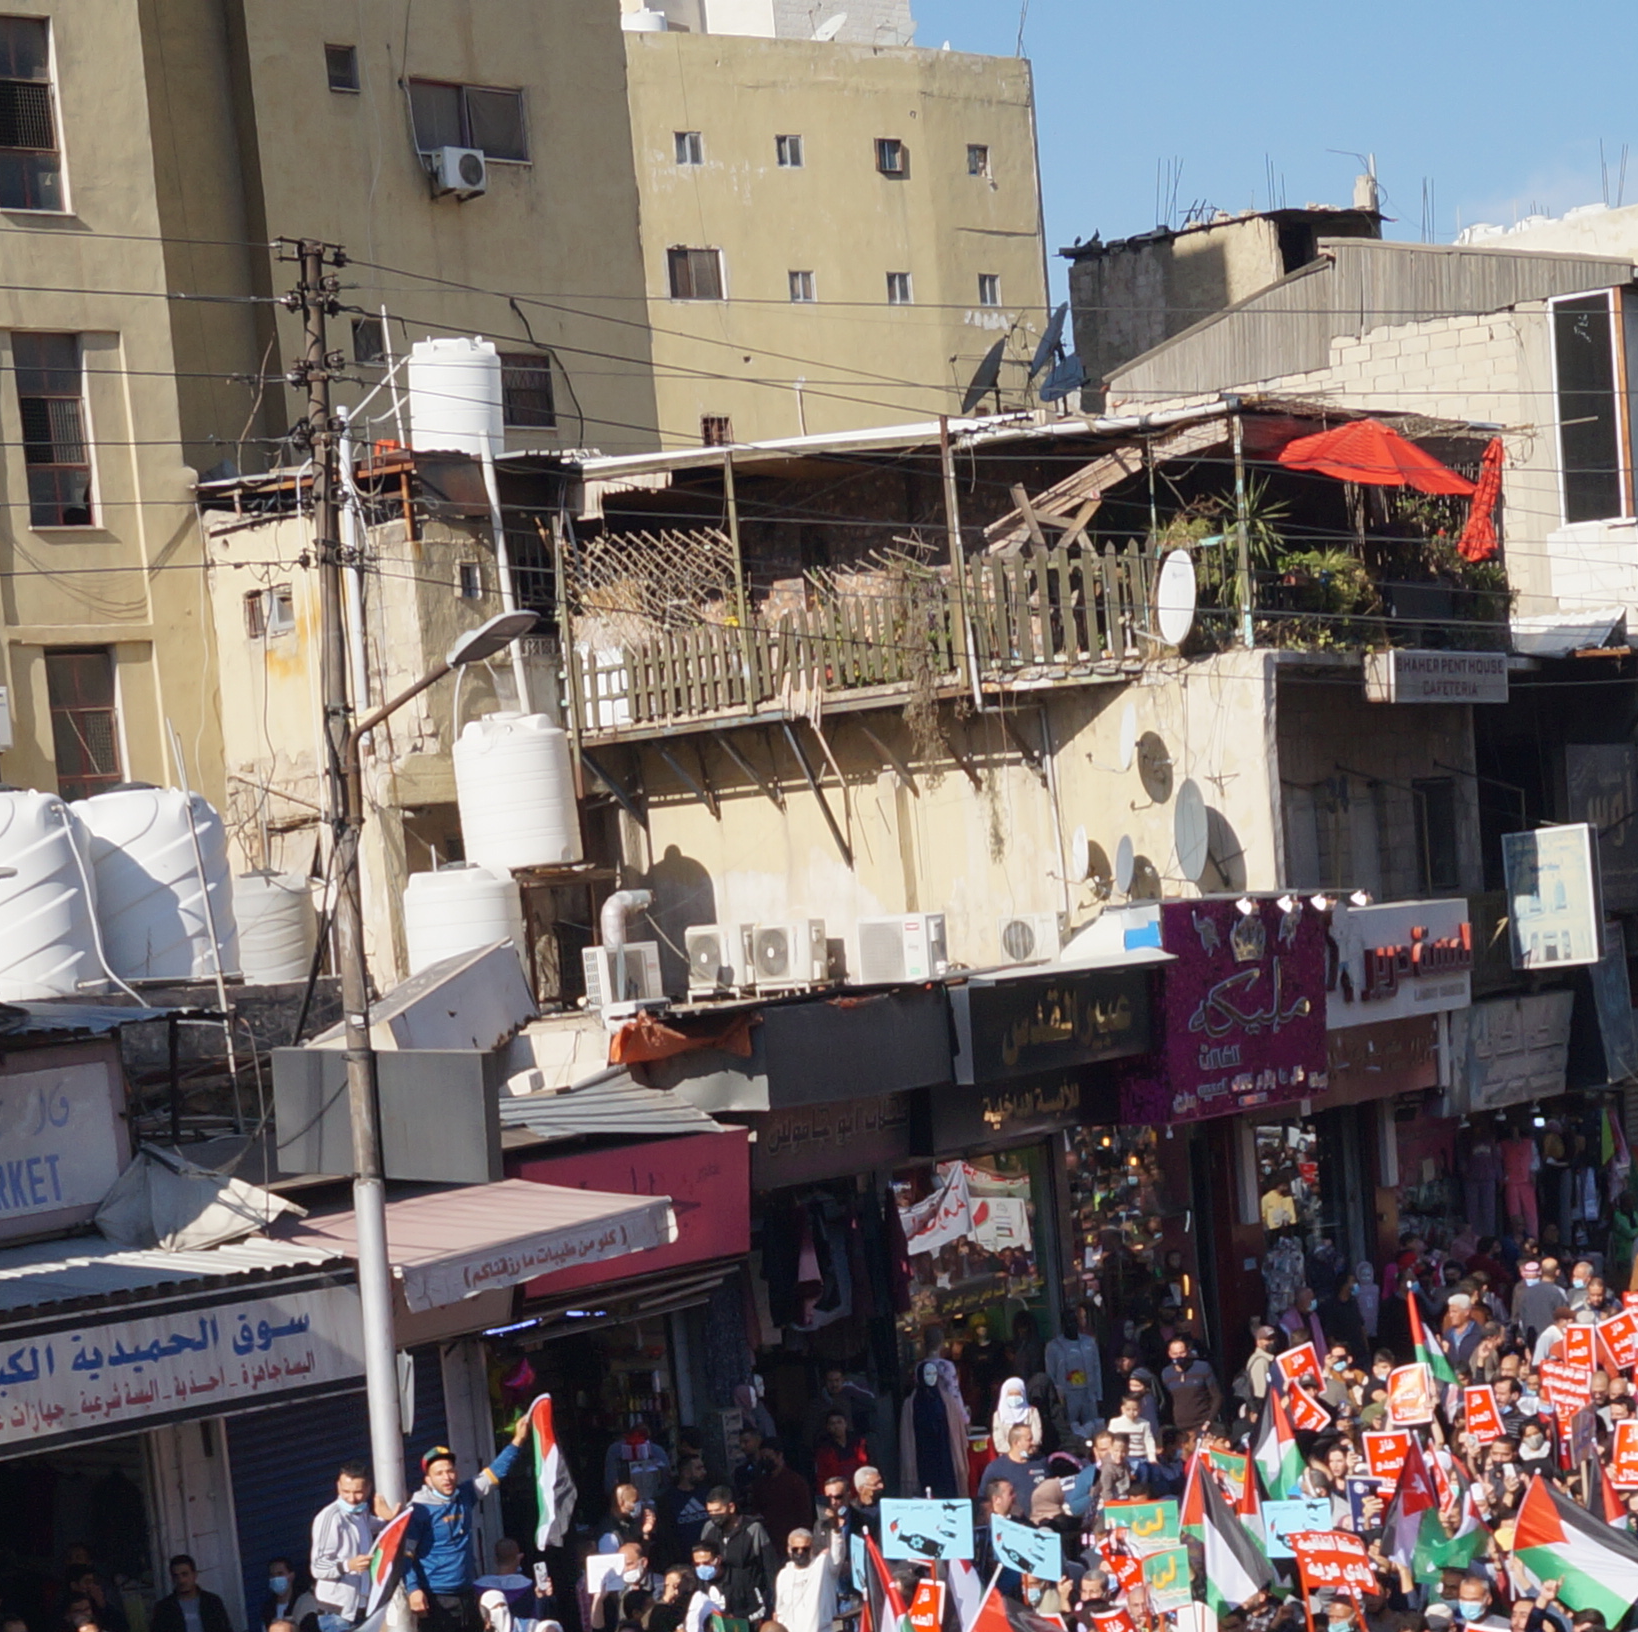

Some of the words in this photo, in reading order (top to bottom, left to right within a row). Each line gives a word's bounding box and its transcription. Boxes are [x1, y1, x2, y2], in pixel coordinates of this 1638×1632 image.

[1422, 680, 1478, 697] CAFETERIA
[232, 1312, 311, 1356] سوق
[1611, 1319, 1629, 1335] غاز
[1571, 1330, 1584, 1342] غاز
[71, 1315, 220, 1381] الحميدية
[1568, 1346, 1588, 1358] العدو
[1290, 1352, 1306, 1369] غاز
[241, 1362, 282, 1387] جاهزة
[80, 1388, 123, 1420] شرعية
[1471, 1393, 1483, 1408] غاز
[9, 1402, 66, 1433] جهازات
[1392, 1404, 1425, 1421] احتلال
[1469, 1411, 1492, 1426] العدو
[1378, 1440, 1395, 1452] غاز
[1374, 1456, 1404, 1471] العدو
[1131, 1506, 1165, 1538] لن
[1151, 1557, 1176, 1591] لن
[1305, 1557, 1341, 1579] عربة
[1343, 1560, 1374, 1587] وادي
